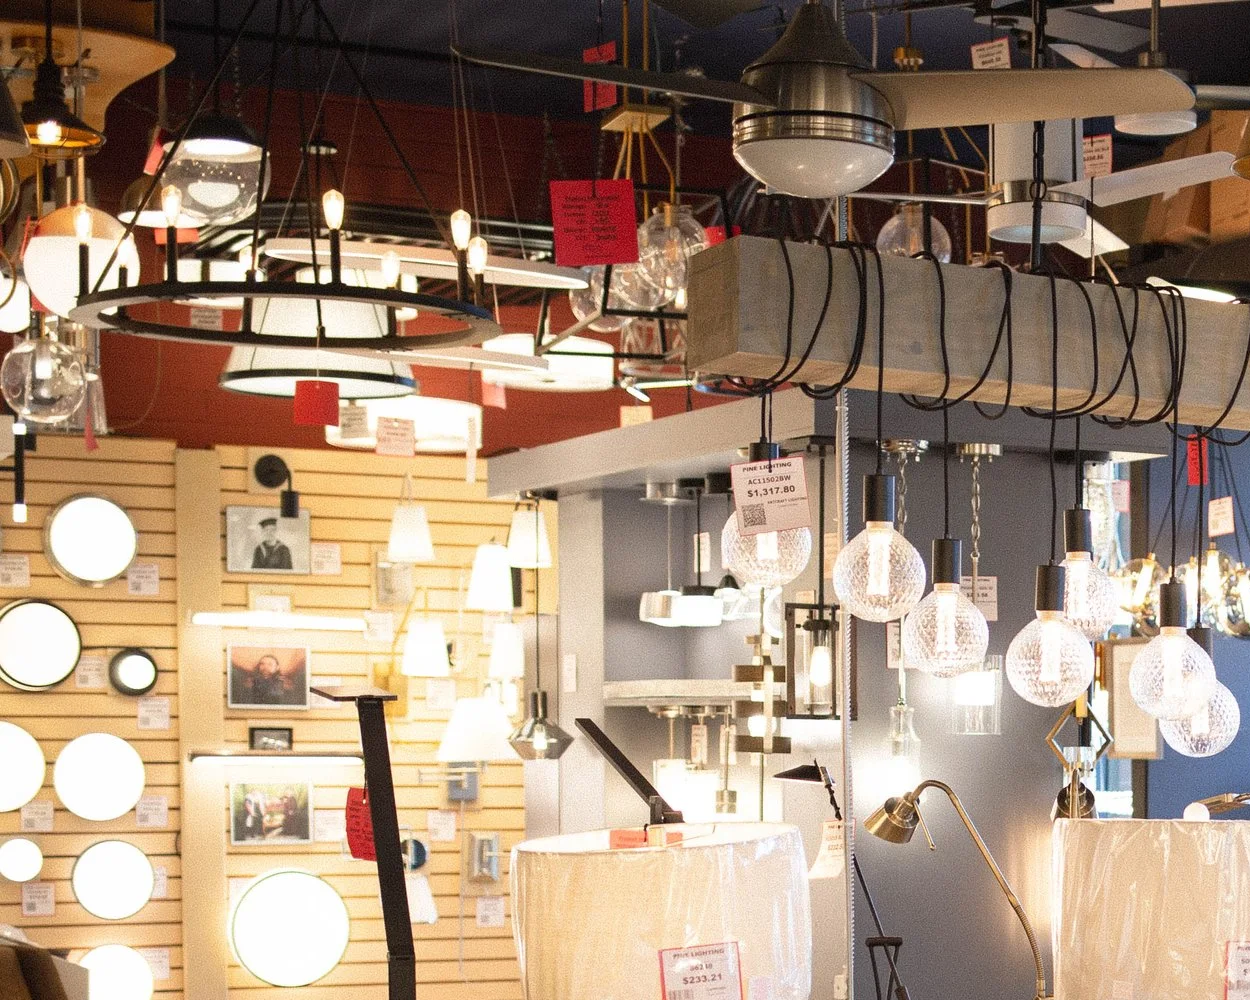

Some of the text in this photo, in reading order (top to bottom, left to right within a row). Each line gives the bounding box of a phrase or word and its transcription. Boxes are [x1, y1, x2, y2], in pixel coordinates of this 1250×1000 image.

[742, 464, 758, 473] PINE
[747, 484, 796, 498] $1,317.80
[682, 973, 722, 985] $233.21
